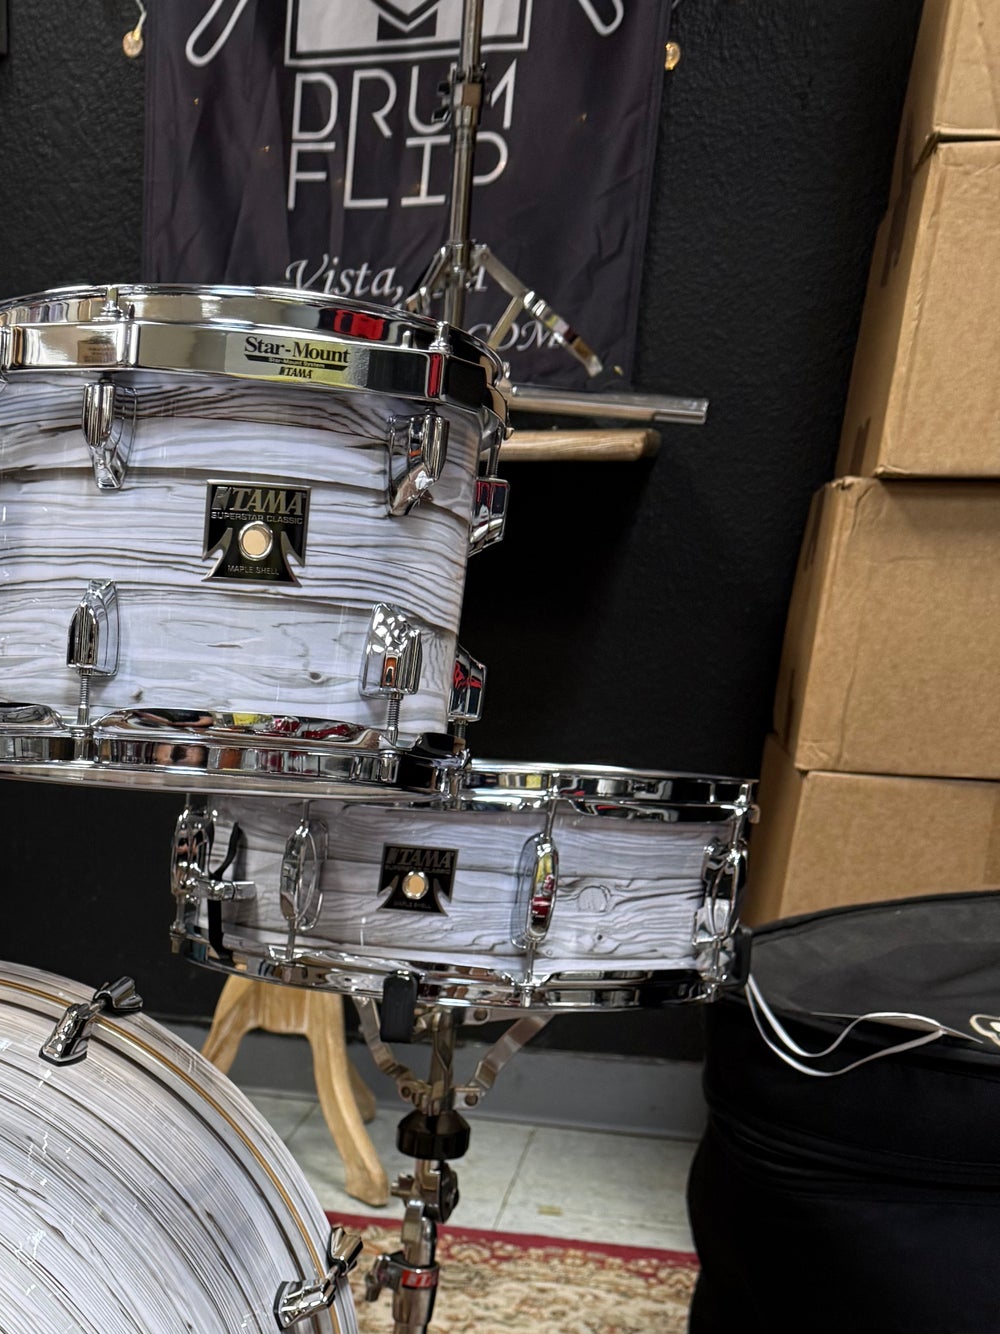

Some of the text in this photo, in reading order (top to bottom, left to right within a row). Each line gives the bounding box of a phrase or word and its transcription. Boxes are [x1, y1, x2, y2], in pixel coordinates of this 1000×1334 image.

[291, 58, 517, 141] DRUM
[287, 131, 509, 210] FLIP
[285, 253, 405, 303] Vista,
[244, 335, 351, 364] Star-Mount
[286, 366, 313, 379] TAMA
[230, 487, 303, 516] TAMA
[210, 511, 303, 525] SUPERSTAR CLASSIC
[227, 564, 280, 576] MAPLE SHELL
[397, 848, 452, 868] TAMA
